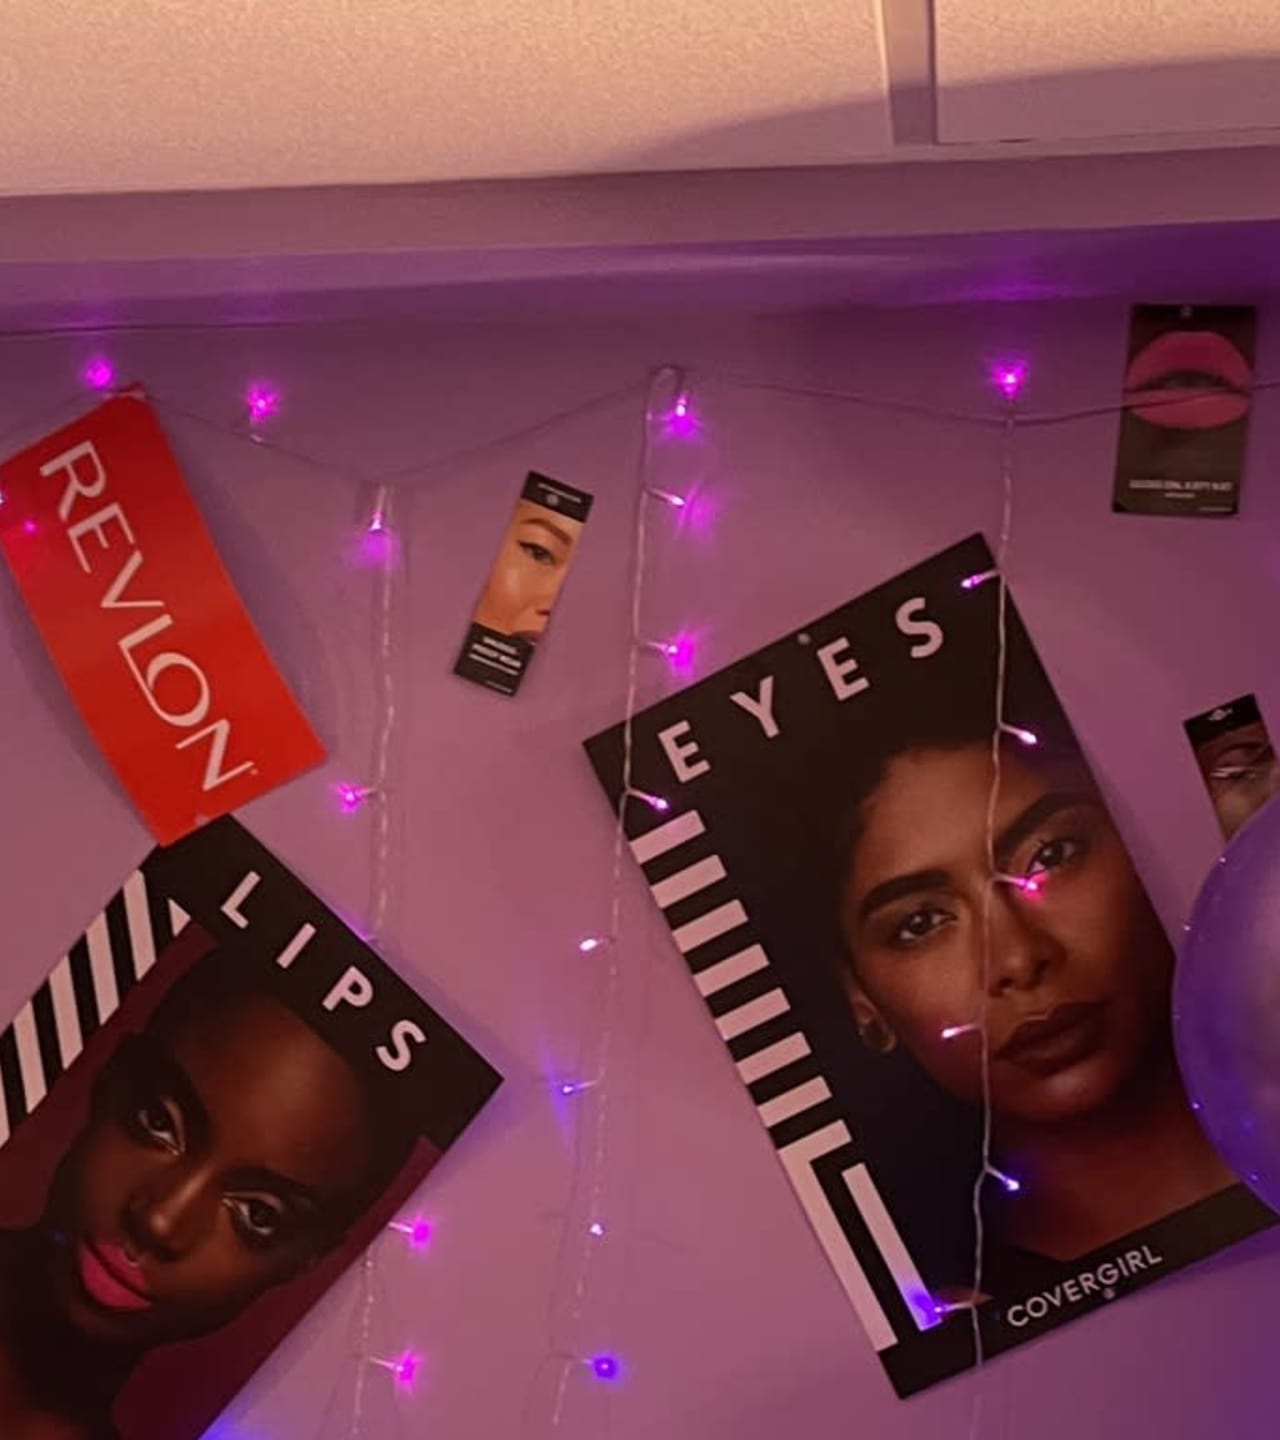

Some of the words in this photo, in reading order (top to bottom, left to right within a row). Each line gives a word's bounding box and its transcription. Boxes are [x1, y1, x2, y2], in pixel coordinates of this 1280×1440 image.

[39, 440, 255, 792] REVLON
[657, 597, 944, 784] EYES
[220, 870, 427, 1072] LIPS
[1007, 1245, 1163, 1327] COVERGIRL
